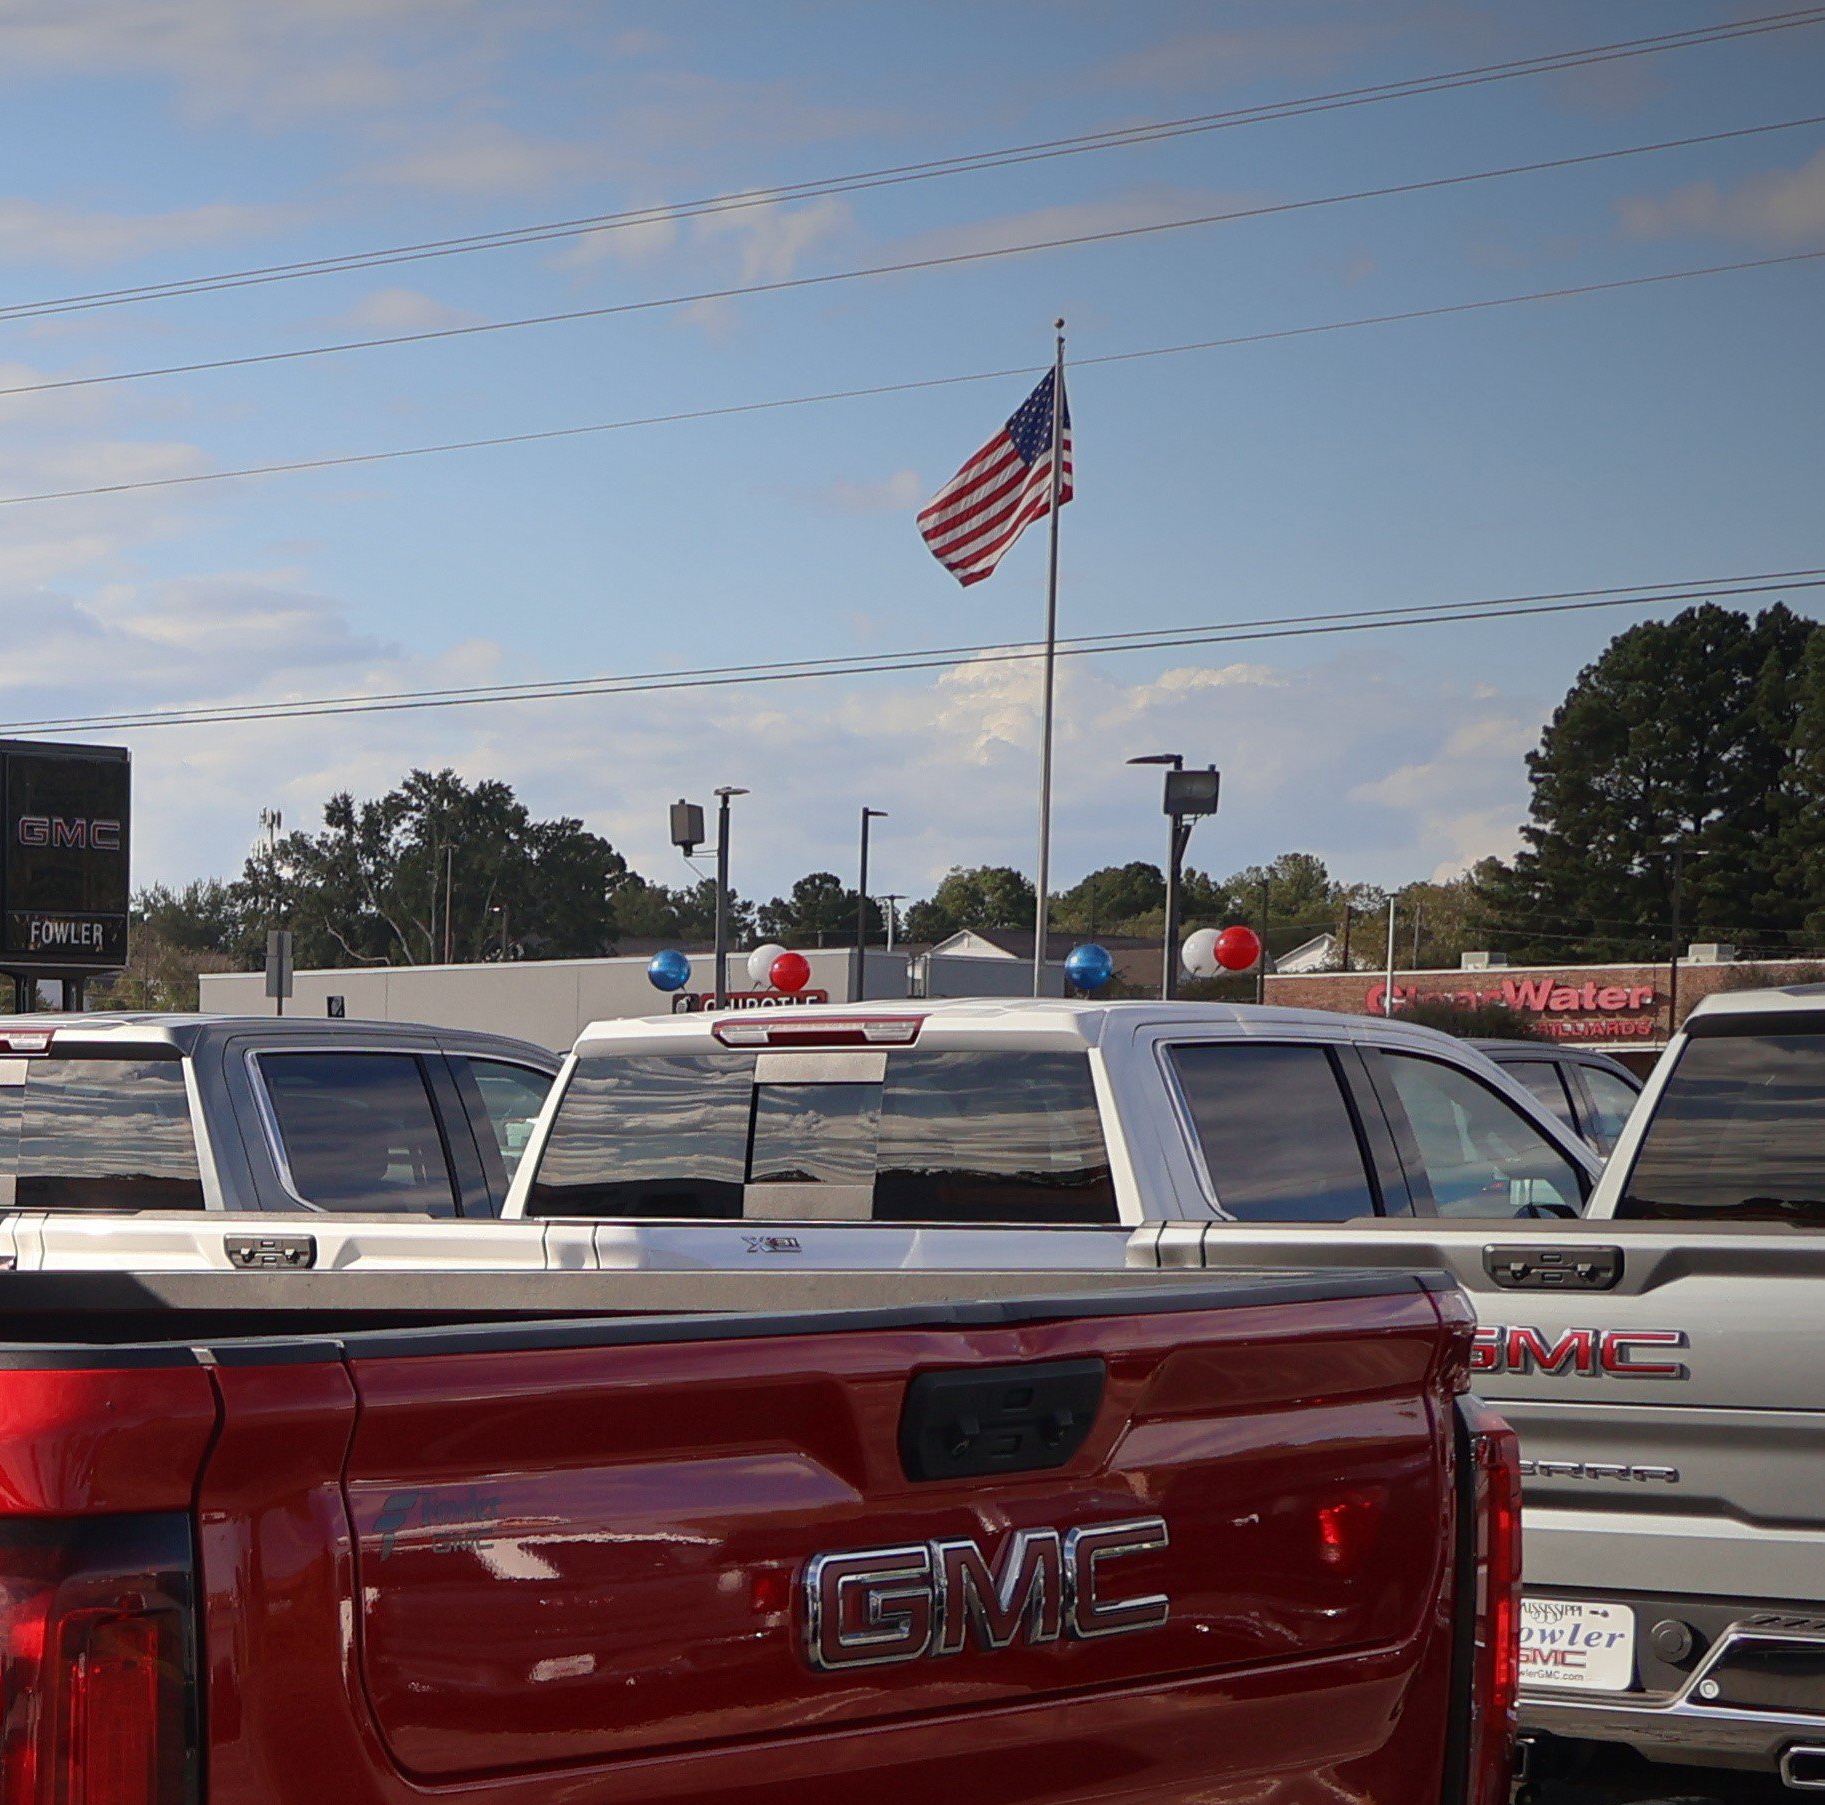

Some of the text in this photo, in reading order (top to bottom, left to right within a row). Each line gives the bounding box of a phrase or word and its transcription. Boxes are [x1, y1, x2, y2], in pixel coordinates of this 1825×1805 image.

[18, 816, 120, 850] GMC
[30, 921, 103, 945] FOWLER
[801, 1515, 1170, 1671] GMC
[1520, 1623, 1626, 1648] owler
